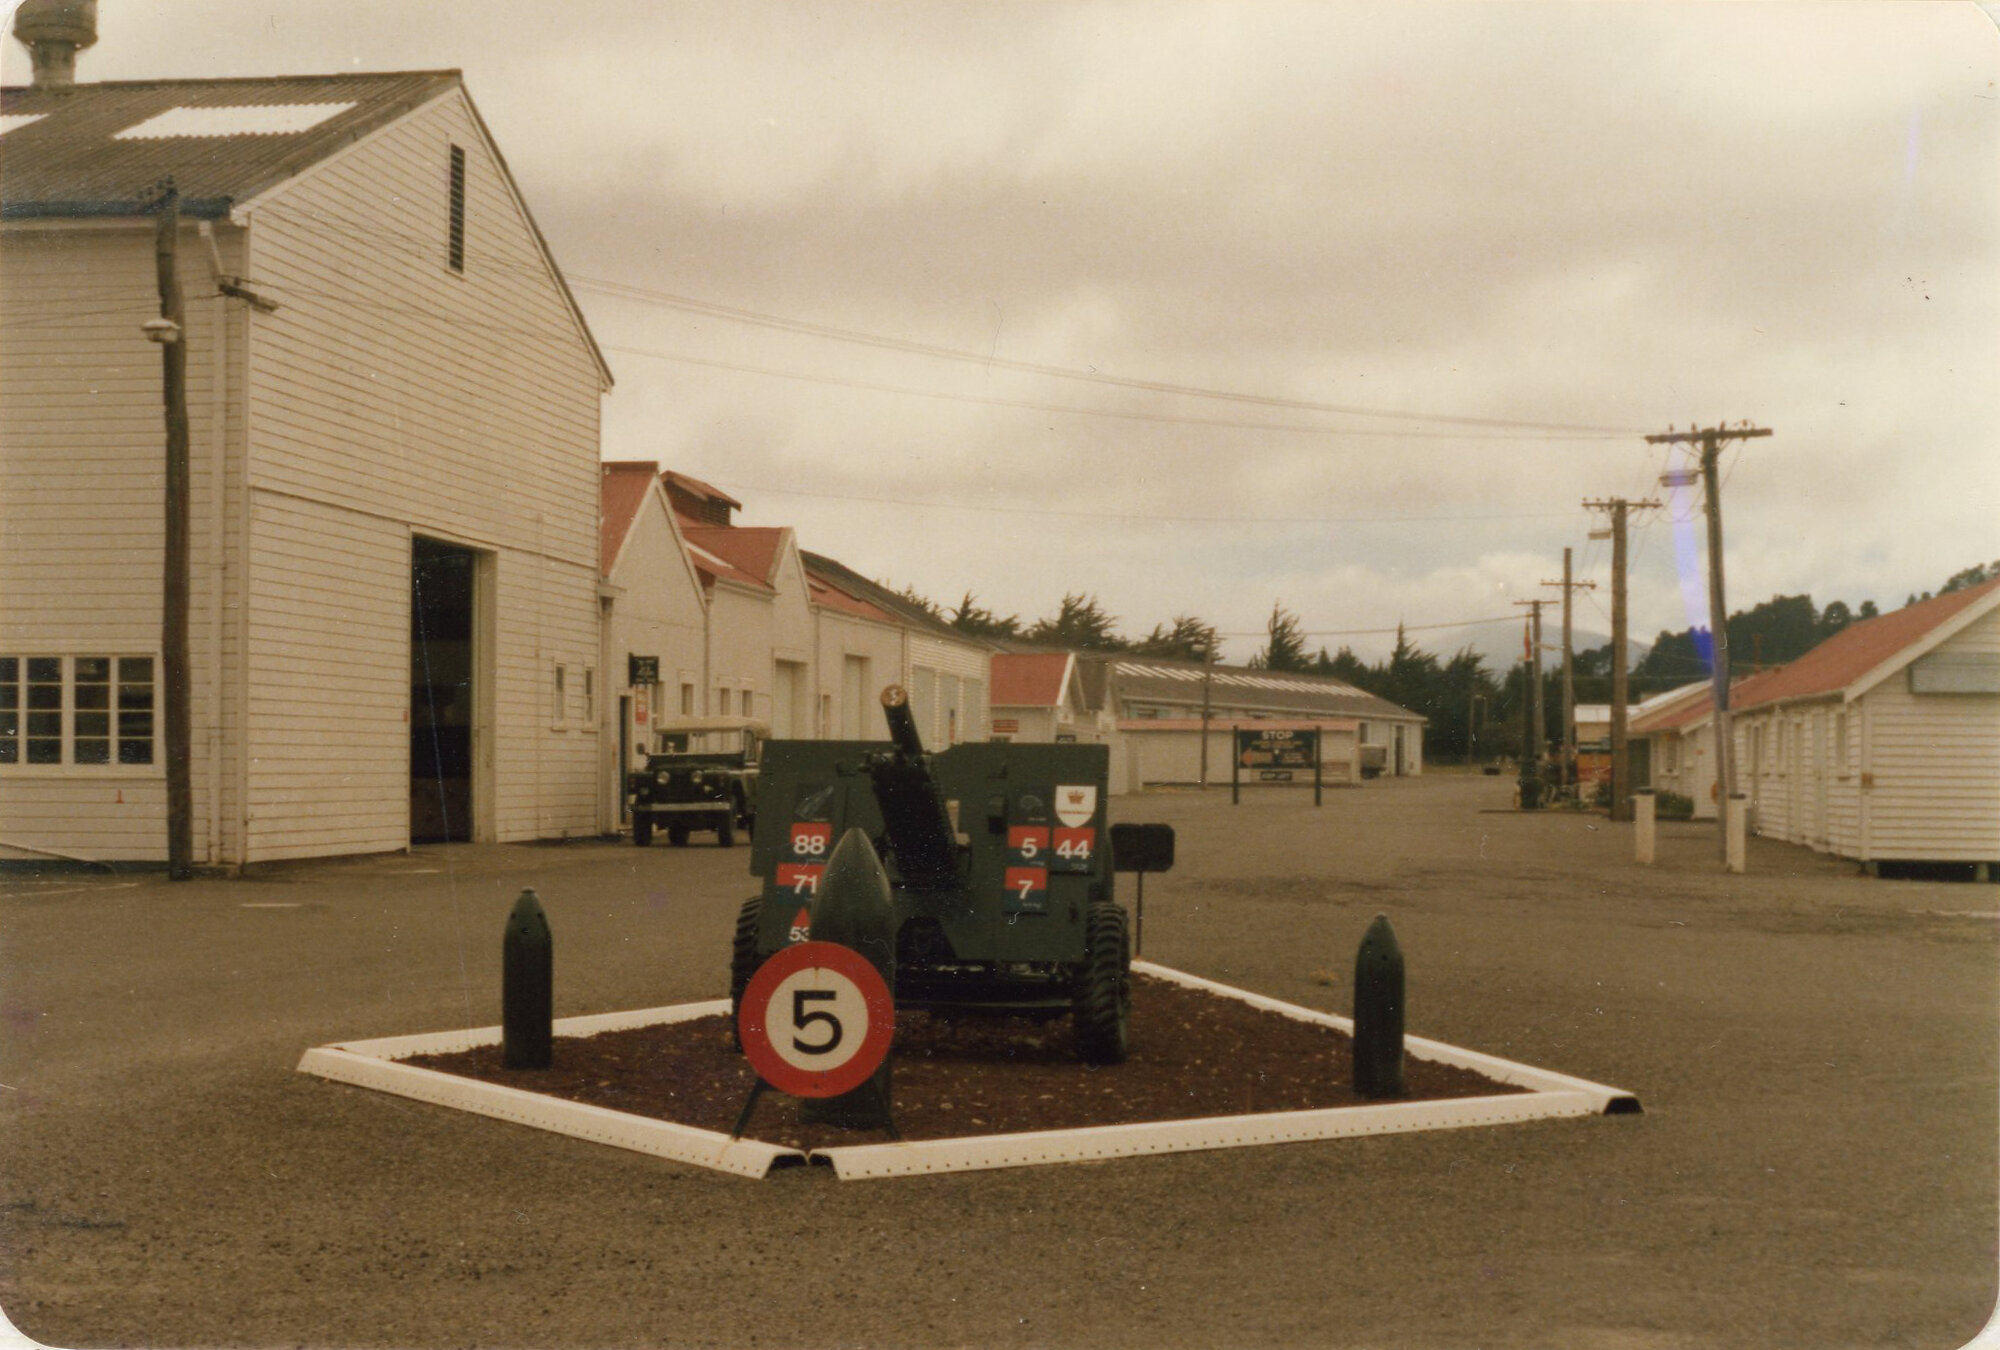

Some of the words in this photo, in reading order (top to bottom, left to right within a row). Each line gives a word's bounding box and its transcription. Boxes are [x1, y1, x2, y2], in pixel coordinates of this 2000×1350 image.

[1262, 731, 1294, 740] STOP
[793, 834, 826, 855] 88
[1020, 837, 1038, 858] 5
[1056, 839, 1090, 859] 44
[793, 875, 818, 894] 71
[1017, 879, 1034, 900] 7
[793, 990, 843, 1055] 5
